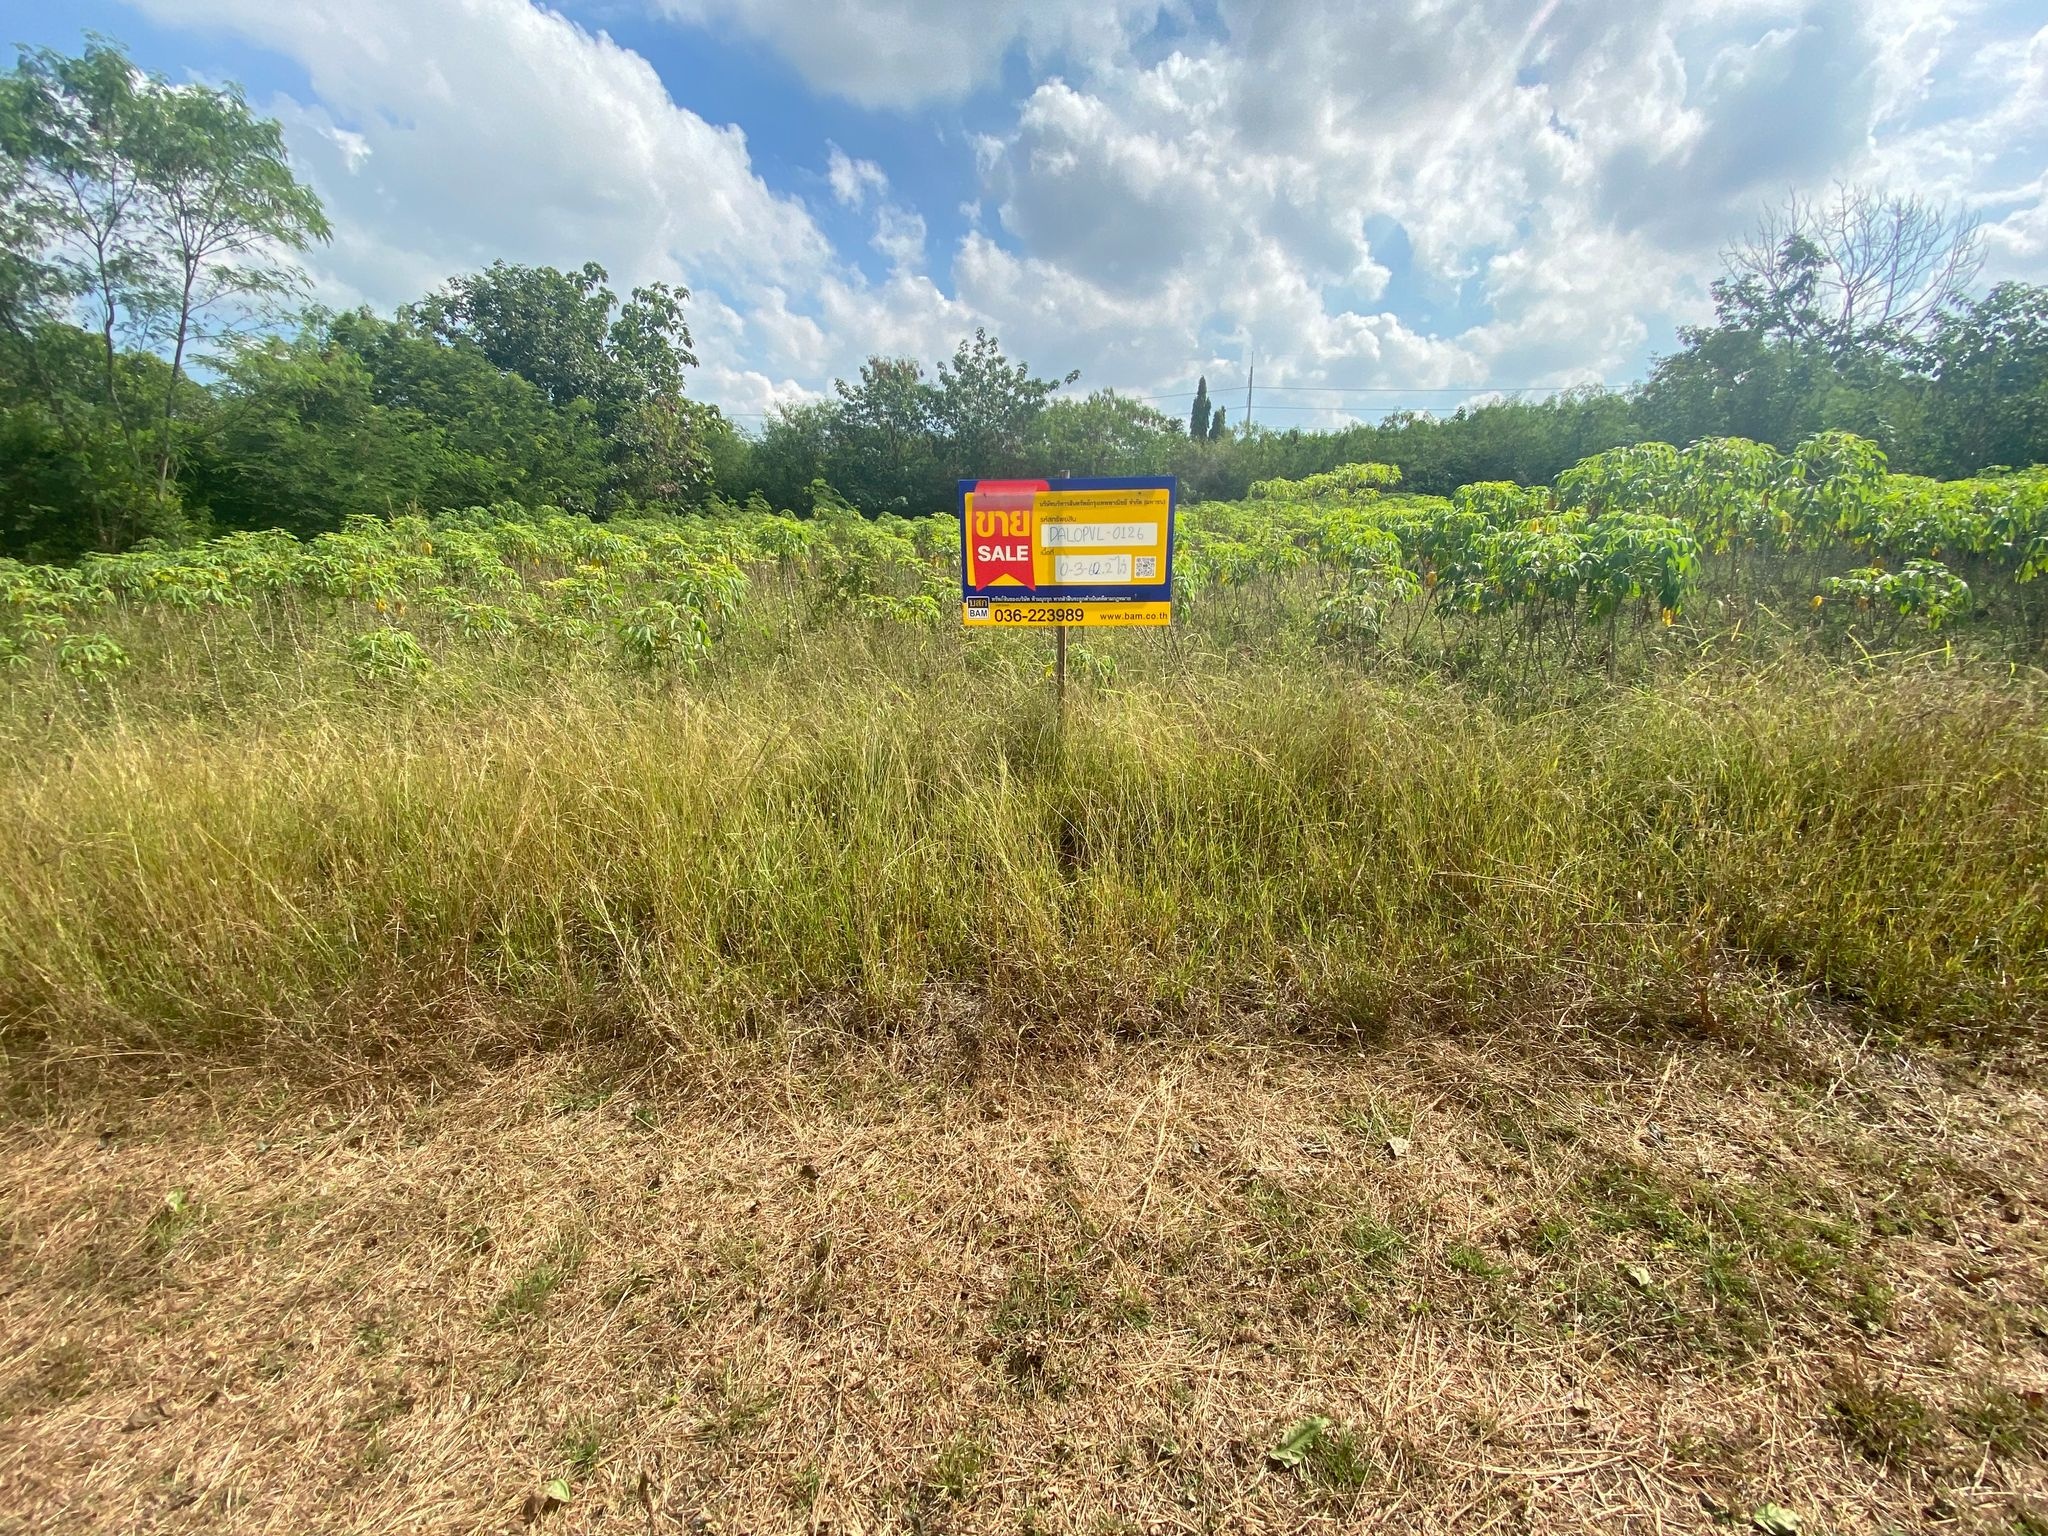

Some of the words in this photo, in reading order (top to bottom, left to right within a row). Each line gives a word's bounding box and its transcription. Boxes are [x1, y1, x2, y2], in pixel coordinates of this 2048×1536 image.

[975, 510, 1030, 538] ขาย
[977, 545, 1029, 562] SALE
[969, 609, 988, 618] BAM
[994, 608, 1085, 622] 036-223989
[1100, 612, 1168, 620] www.bam.co.th
